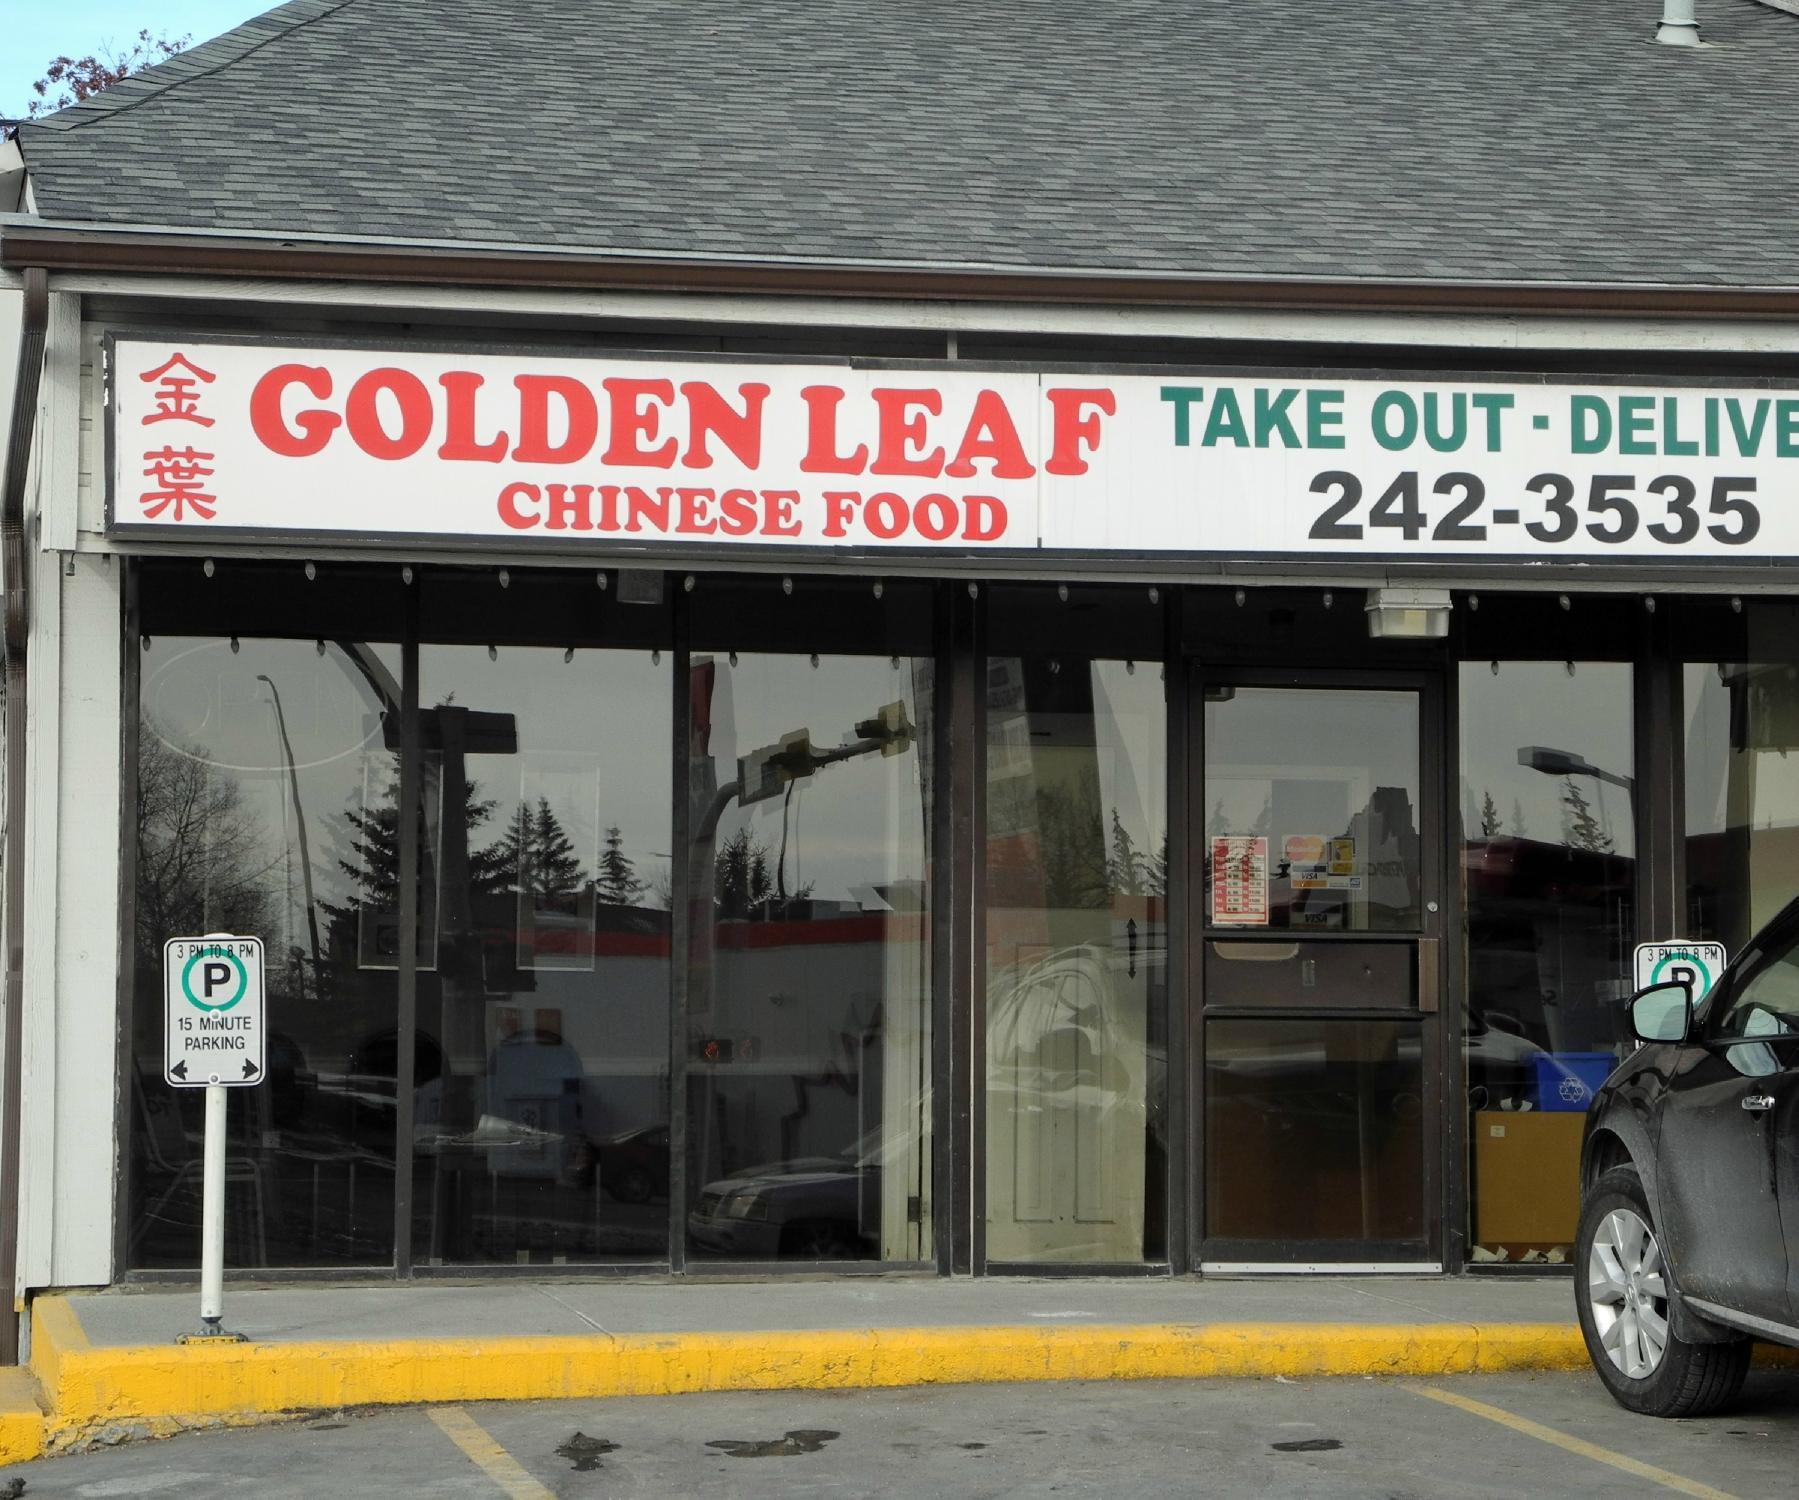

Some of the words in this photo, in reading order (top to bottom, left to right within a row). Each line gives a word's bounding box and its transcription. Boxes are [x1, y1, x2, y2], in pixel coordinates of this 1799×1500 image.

[250, 363, 770, 470] GOLDEN
[800, 385, 1117, 480] LEAF
[1161, 386, 1345, 449] TAKE
[1371, 391, 1515, 452] OUT
[140, 352, 216, 521] 金葉
[498, 482, 803, 537] CHINESE
[823, 491, 1008, 542] FOOD
[1308, 471, 1761, 545] 242-3535
[1301, 872, 1318, 880] VISA
[1304, 913, 1328, 924] VISA
[176, 944, 184, 958] 3
[189, 944, 204, 958] PM
[209, 944, 222, 958] TO
[227, 944, 234, 958] 8
[239, 944, 254, 958] PM
[1648, 948, 1654, 961] 3
[1658, 948, 1672, 961] PM
[1676, 948, 1689, 960] TO
[1704, 947, 1718, 960] PM
[203, 963, 231, 998] P
[178, 1017, 193, 1031] 15
[199, 1016, 252, 1031] MINUTE
[184, 1036, 246, 1051] PARKING
